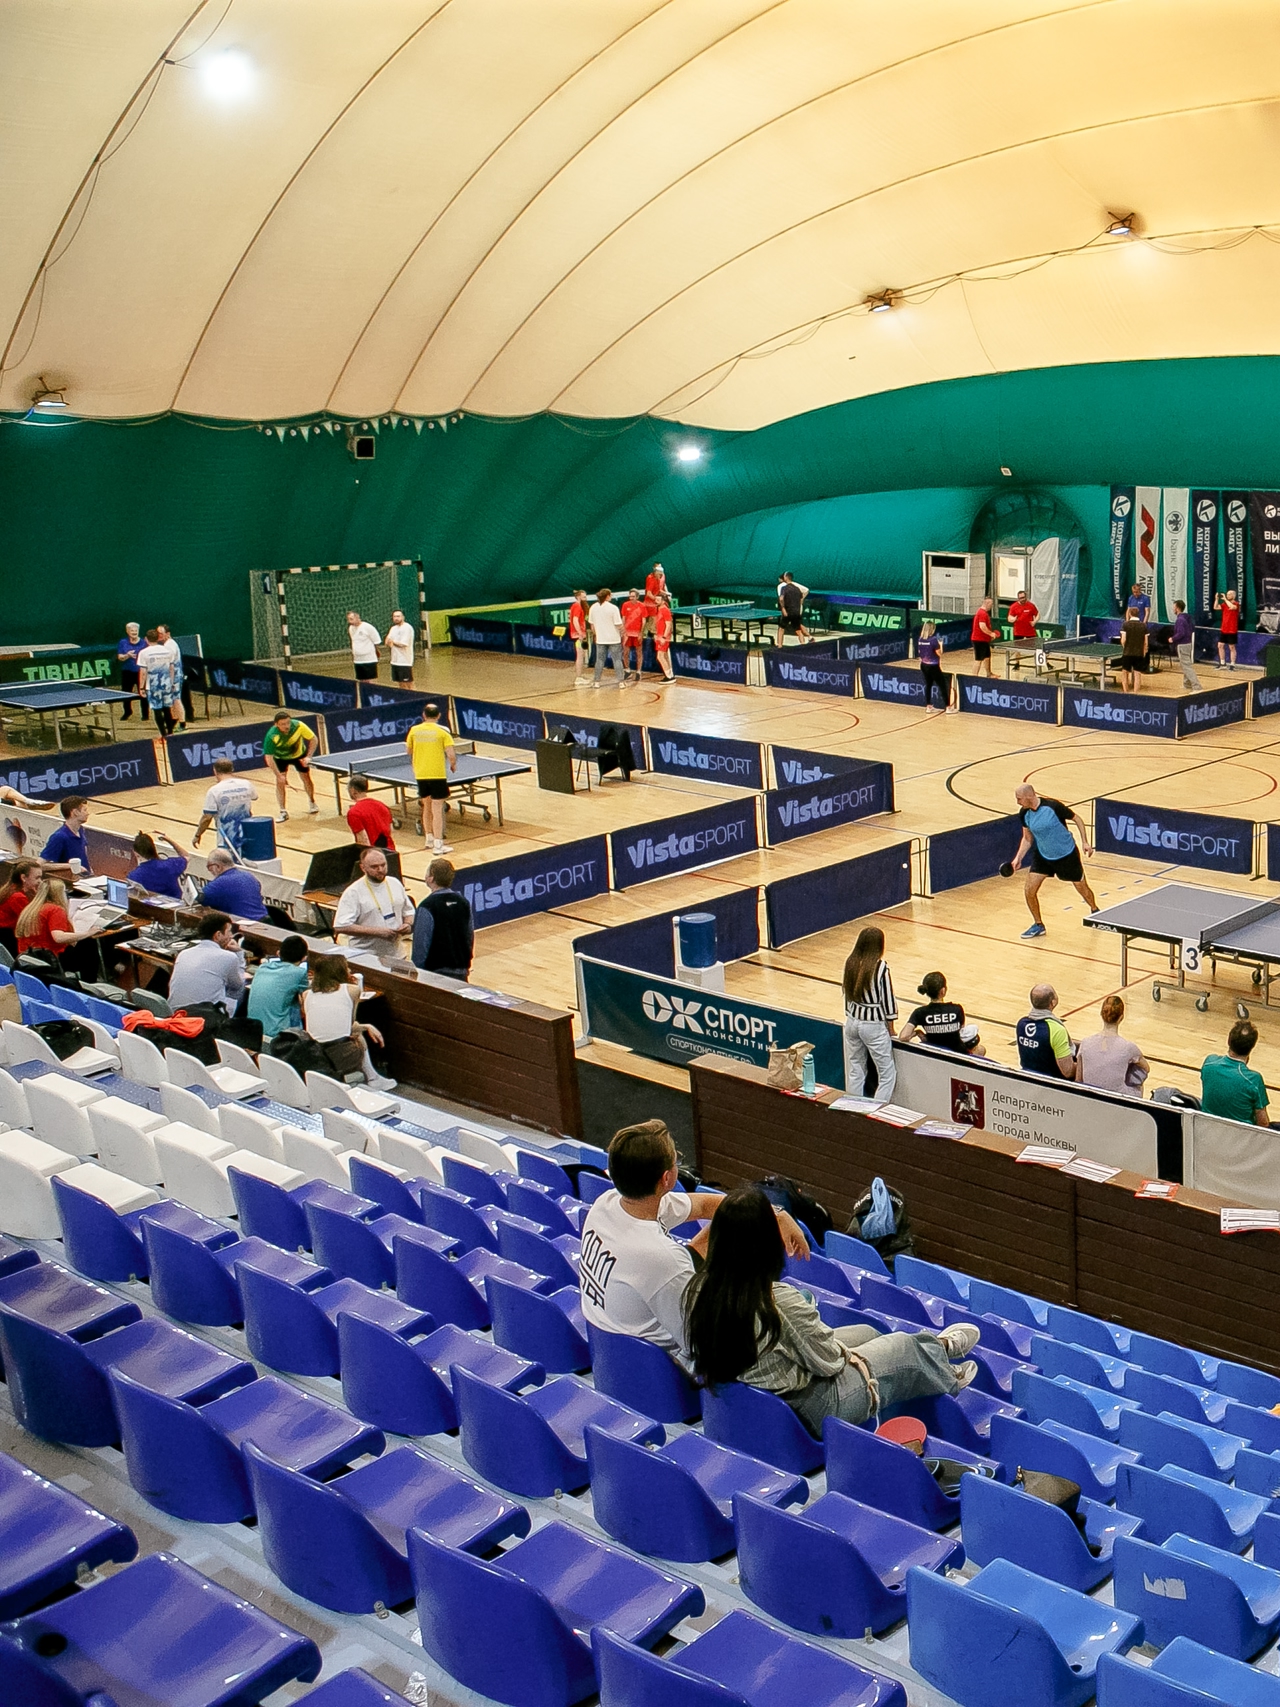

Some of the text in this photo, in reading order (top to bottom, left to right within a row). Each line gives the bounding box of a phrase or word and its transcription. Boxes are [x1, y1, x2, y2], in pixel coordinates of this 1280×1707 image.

[694, 617, 701, 628] 5
[838, 610, 902, 629] DONIC
[23, 659, 111, 682] TIBHAR
[1036, 650, 1046, 666] 6
[779, 661, 851, 688] VistaSPORT
[965, 684, 1050, 714] VistaSPORT
[1184, 697, 1244, 725] VistaSPORT
[462, 708, 538, 741] VistaSPORT
[1074, 698, 1170, 728] VistaSPORT
[658, 740, 752, 776] VistaSPORT
[778, 783, 876, 828] VistaSPORT
[626, 818, 747, 869] VistaSPORT
[1108, 814, 1241, 859] VistaSPORT
[1097, 923, 1118, 933] JOOLA
[1185, 947, 1200, 971] 3
[704, 1005, 777, 1043] СПОРТ
[925, 1012, 958, 1025] СБЕР
[706, 1028, 771, 1052] консалтин
[1018, 1036, 1039, 1049] СБЕР
[992, 1090, 1066, 1118] Департамент
[992, 1107, 1030, 1124] спорта
[992, 1122, 1077, 1152] города Москвы
